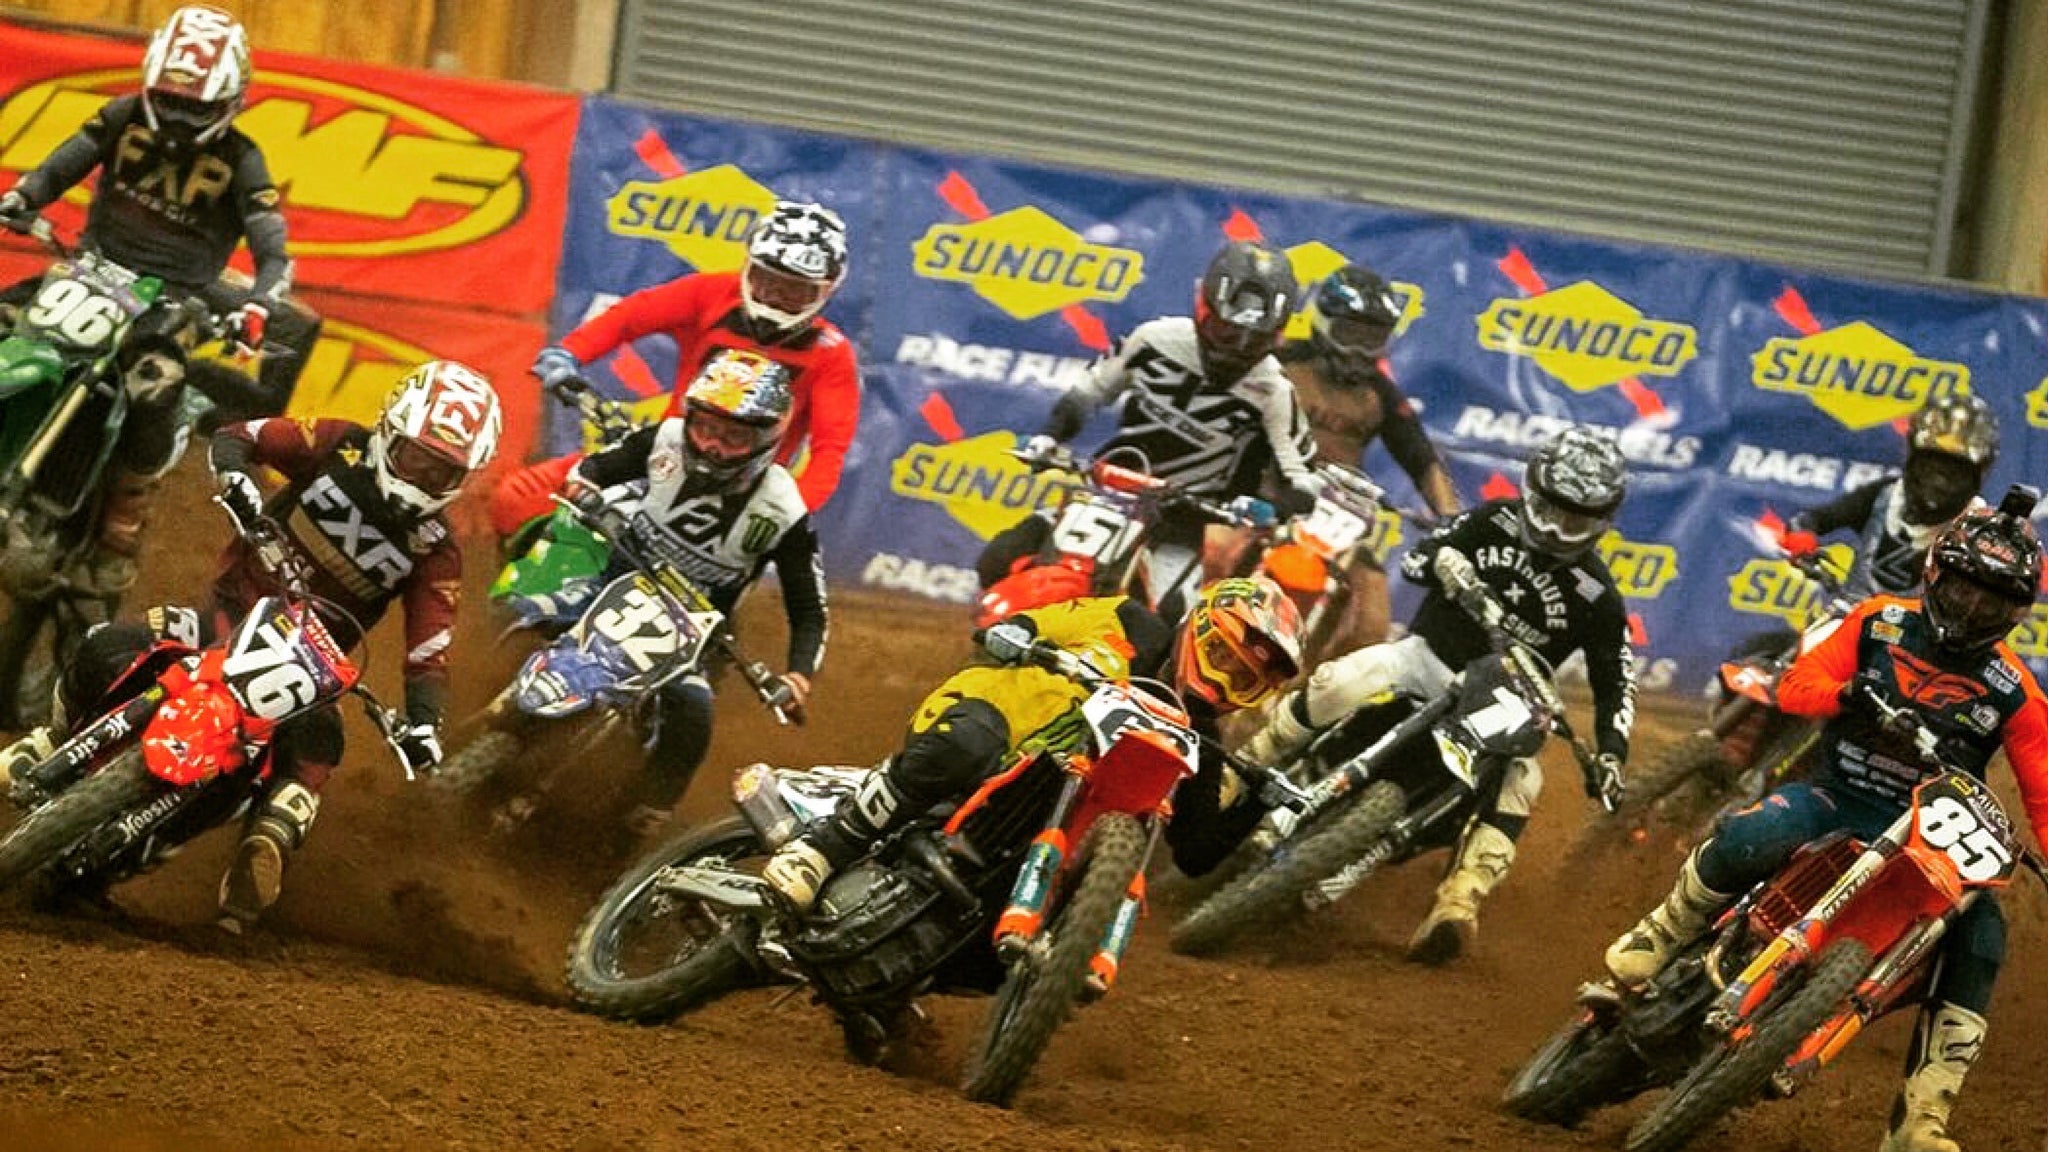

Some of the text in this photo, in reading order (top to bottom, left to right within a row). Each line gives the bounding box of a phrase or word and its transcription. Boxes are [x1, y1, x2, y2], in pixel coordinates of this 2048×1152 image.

[618, 191, 758, 242] SUNO
[924, 232, 1130, 293] SUNOCO
[28, 279, 120, 347] 96
[1488, 307, 1687, 367] SUNOCO
[896, 332, 1013, 383] RACE
[1763, 346, 1959, 401] SUNOCO
[902, 452, 1066, 511] SUNOC
[1729, 444, 1842, 491] RACE
[301, 474, 414, 590] FXR
[593, 589, 678, 672] 32
[222, 622, 317, 720] 76
[1918, 796, 2013, 881] 85
